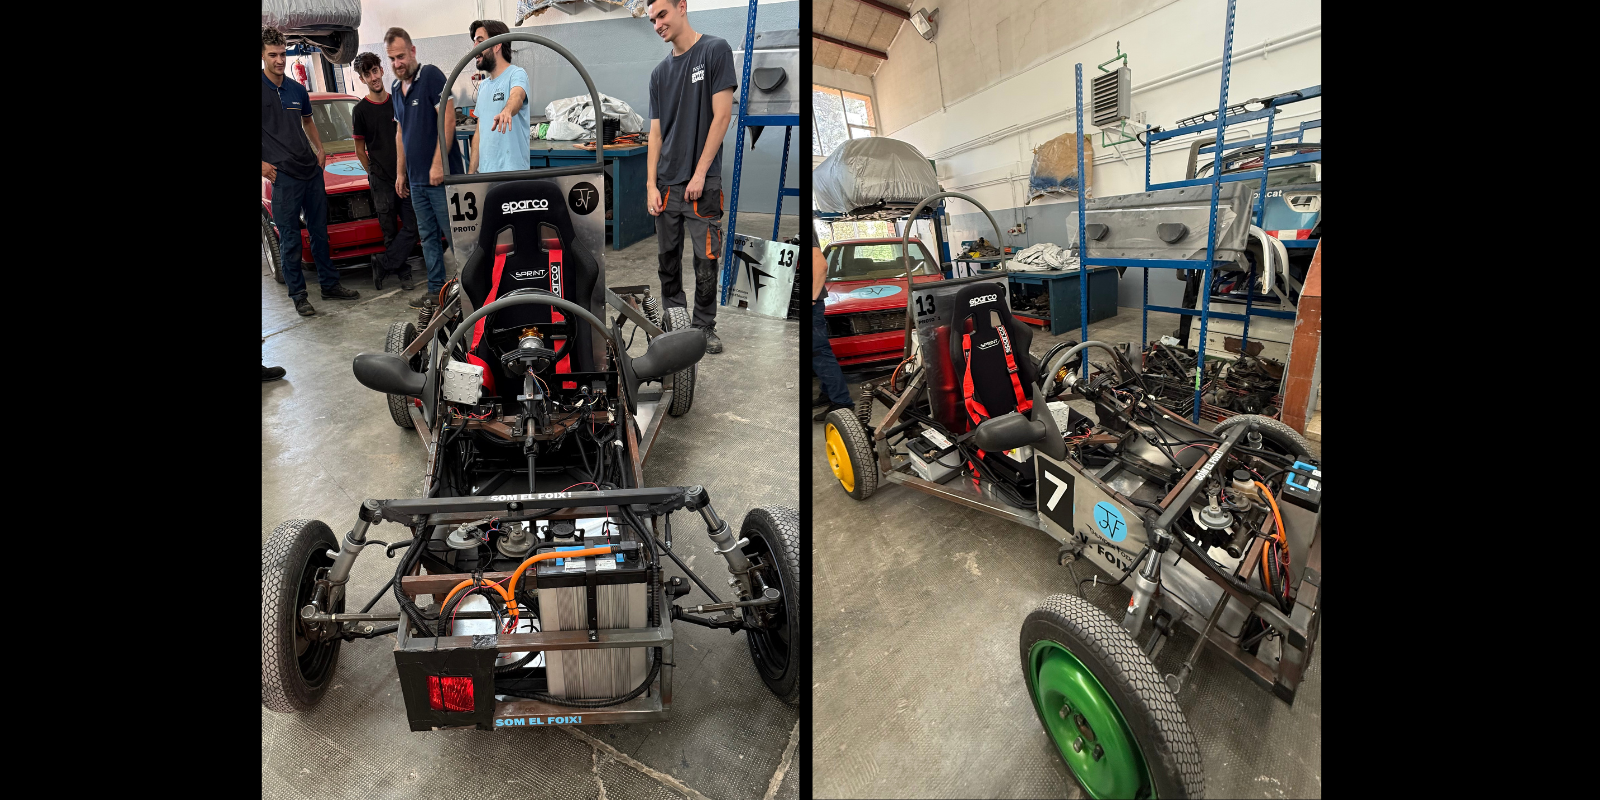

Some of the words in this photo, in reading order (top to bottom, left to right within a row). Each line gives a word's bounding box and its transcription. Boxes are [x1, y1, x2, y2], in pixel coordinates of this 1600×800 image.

[450, 191, 478, 221] 13
[502, 198, 549, 214] sparco
[777, 248, 794, 268] 13
[515, 269, 546, 277] SPRINT
[916, 294, 936, 317] 13
[969, 293, 998, 307] sparco
[490, 494, 518, 502] SOM
[1044, 469, 1068, 512] 7
[495, 718, 525, 727] SOM
[528, 717, 544, 725] EL
[548, 716, 582, 724] FOIX!
